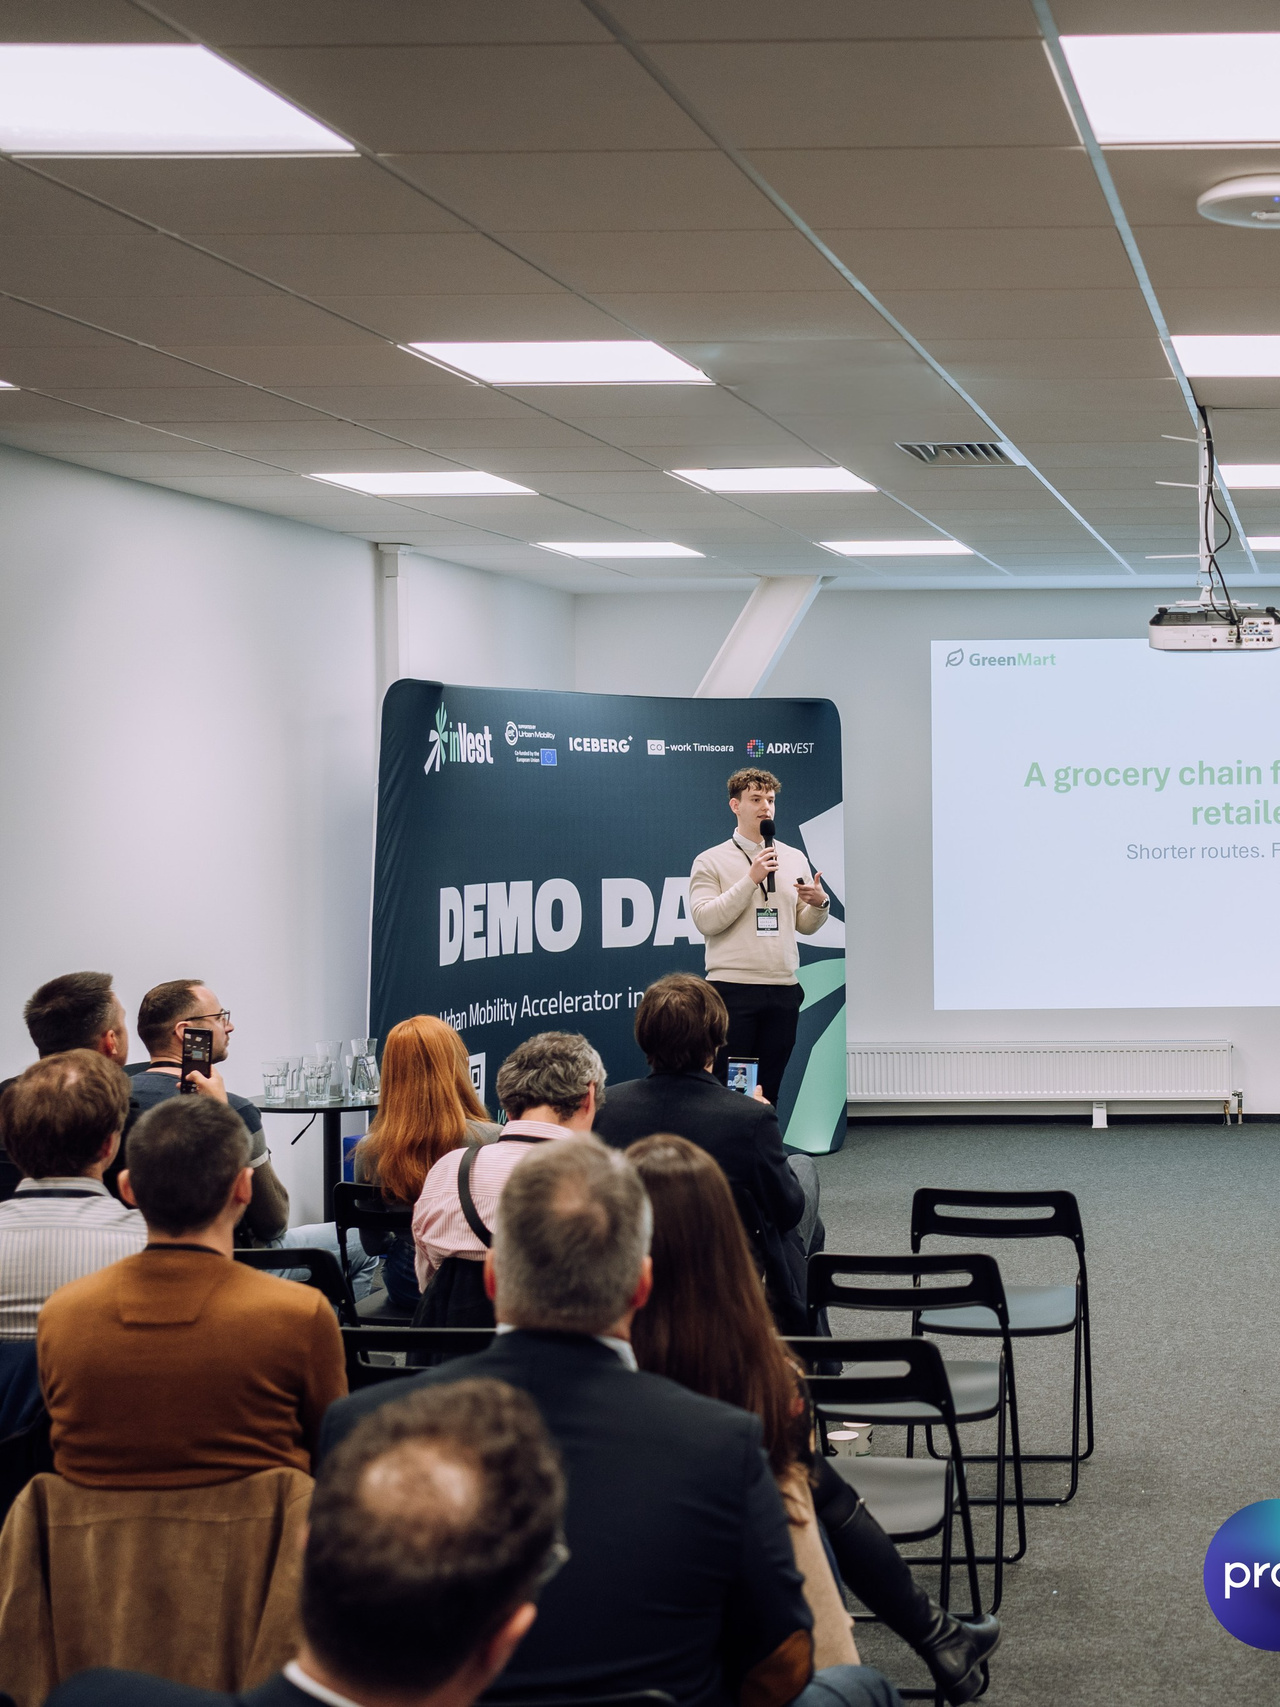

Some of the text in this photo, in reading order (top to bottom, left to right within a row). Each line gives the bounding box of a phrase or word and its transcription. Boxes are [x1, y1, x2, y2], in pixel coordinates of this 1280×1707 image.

[968, 652, 1057, 667] GreenMart
[449, 721, 494, 765] inVest
[518, 730, 556, 740] Urban Mobility
[693, 742, 734, 753] Timisoara
[766, 742, 815, 754] ADRVEST
[1023, 761, 1047, 788] A
[1053, 763, 1171, 793] grocery
[1178, 760, 1263, 787] chain
[1126, 843, 1197, 860] Shorter
[1201, 843, 1266, 860] routes.
[439, 876, 706, 967] DEMO DA
[469, 997, 518, 1027] Mobility
[520, 989, 623, 1018] Accelerator
[627, 986, 646, 1009] in
